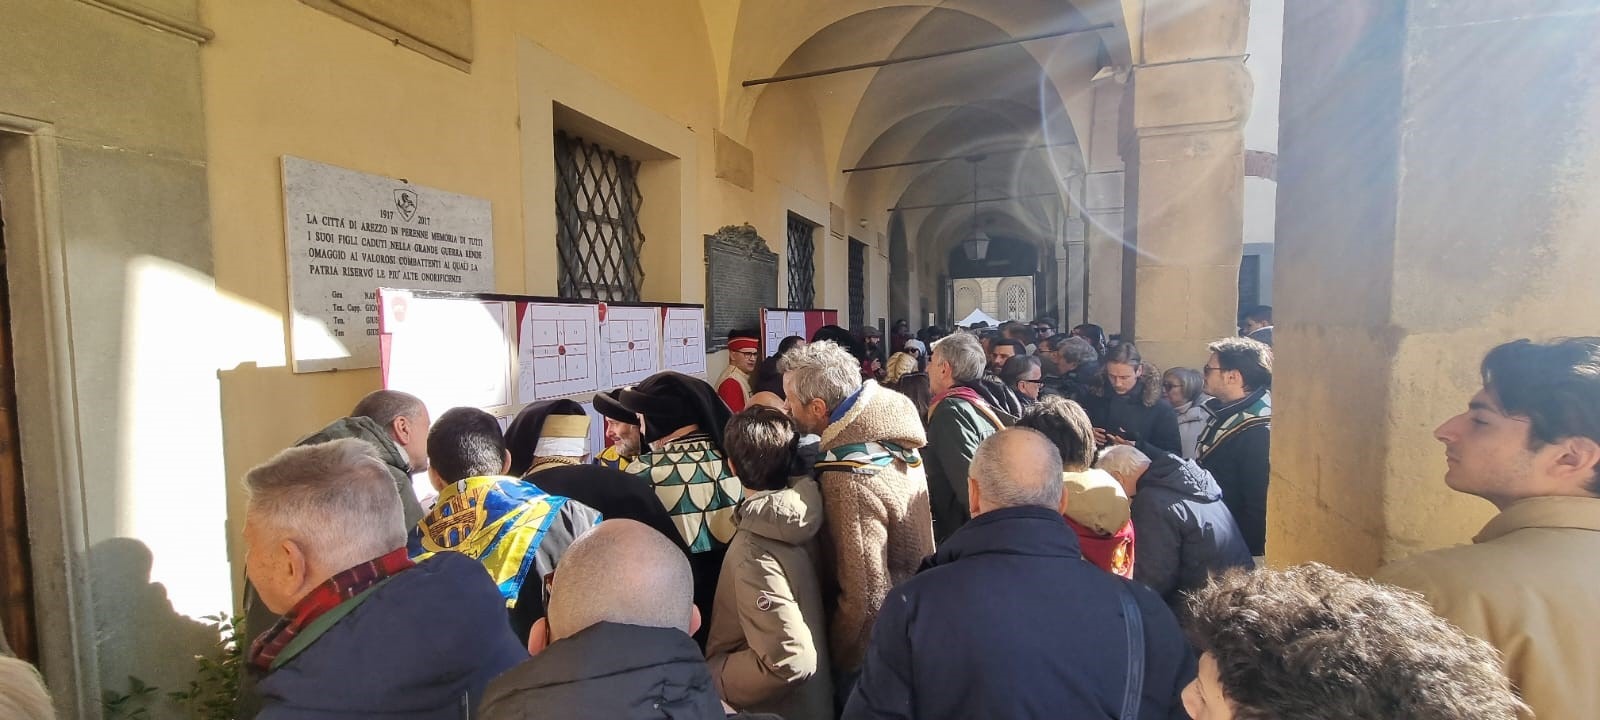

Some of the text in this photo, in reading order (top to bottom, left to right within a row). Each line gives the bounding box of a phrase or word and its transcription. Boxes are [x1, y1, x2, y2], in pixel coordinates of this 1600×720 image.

[380, 210, 430, 225] 1917 2017
[306, 214, 318, 224] LA
[349, 220, 357, 230] DI
[361, 222, 387, 233] AREZZO
[391, 226, 398, 235] IN
[402, 228, 428, 239] PERENNE
[432, 232, 457, 243] MEMORIA
[460, 236, 466, 244] DI
[468, 238, 483, 246] TUTTI
[308, 231, 482, 259] I SUOI FIGLI CADUTI NELLA GRANDE GUERRA RENDE
[309, 248, 478, 272] OMAGGIO AI VALOROSI COMBATTENTI AI QUALI LA
[309, 265, 338, 276] PATRIA
[377, 269, 385, 278] LE
[403, 272, 418, 280] ALTE
[421, 273, 462, 283] ONORIFICENZE
